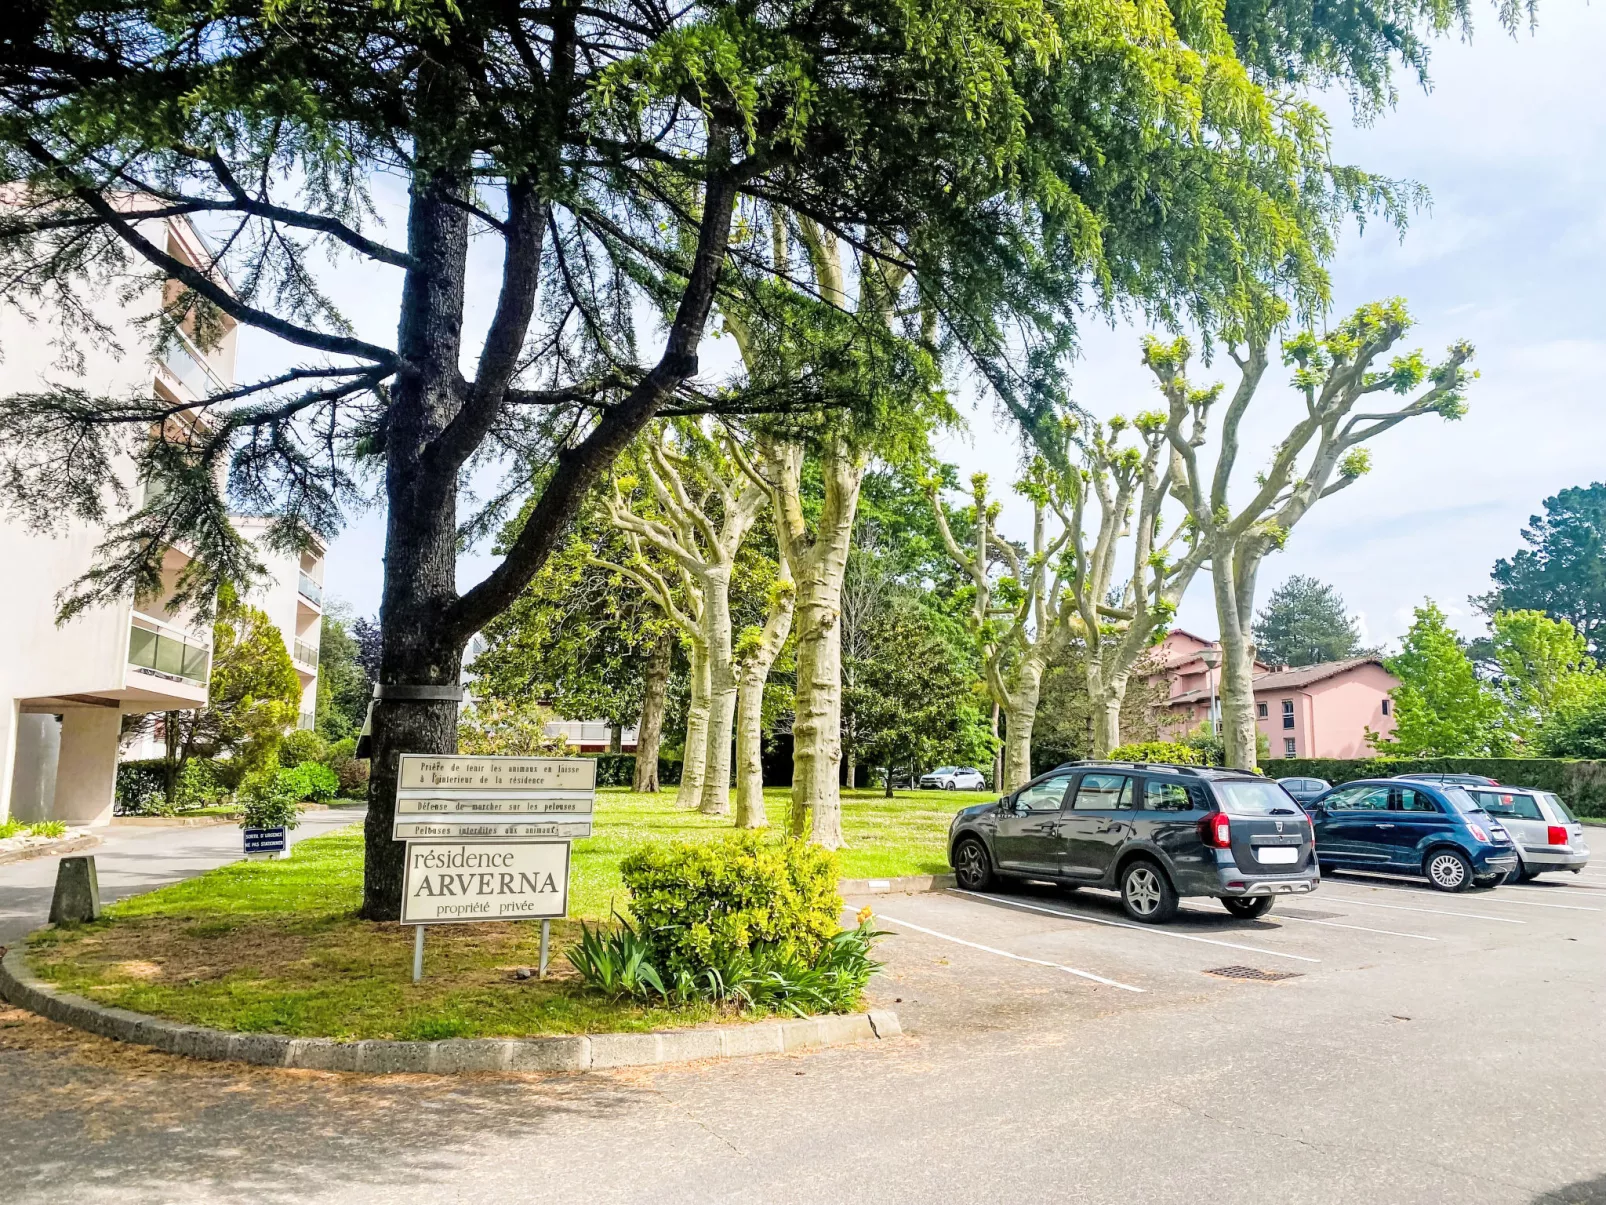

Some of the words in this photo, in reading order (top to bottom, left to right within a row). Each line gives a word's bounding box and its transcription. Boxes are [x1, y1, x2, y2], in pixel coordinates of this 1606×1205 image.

[451, 764, 460, 772] de
[466, 764, 484, 772] tenir
[491, 764, 502, 773] les
[508, 765, 538, 773] animaux
[544, 765, 552, 773] en
[558, 764, 580, 773] laisse
[420, 775, 424, 783] à
[496, 776, 502, 784] la
[456, 802, 464, 810] de
[472, 802, 502, 810] marcher
[528, 802, 538, 810] les
[544, 802, 576, 812] pelouses
[414, 846, 514, 869] résidence
[414, 872, 560, 897] ARVERNA
[436, 902, 491, 917] propriété
[500, 900, 534, 915] privée
